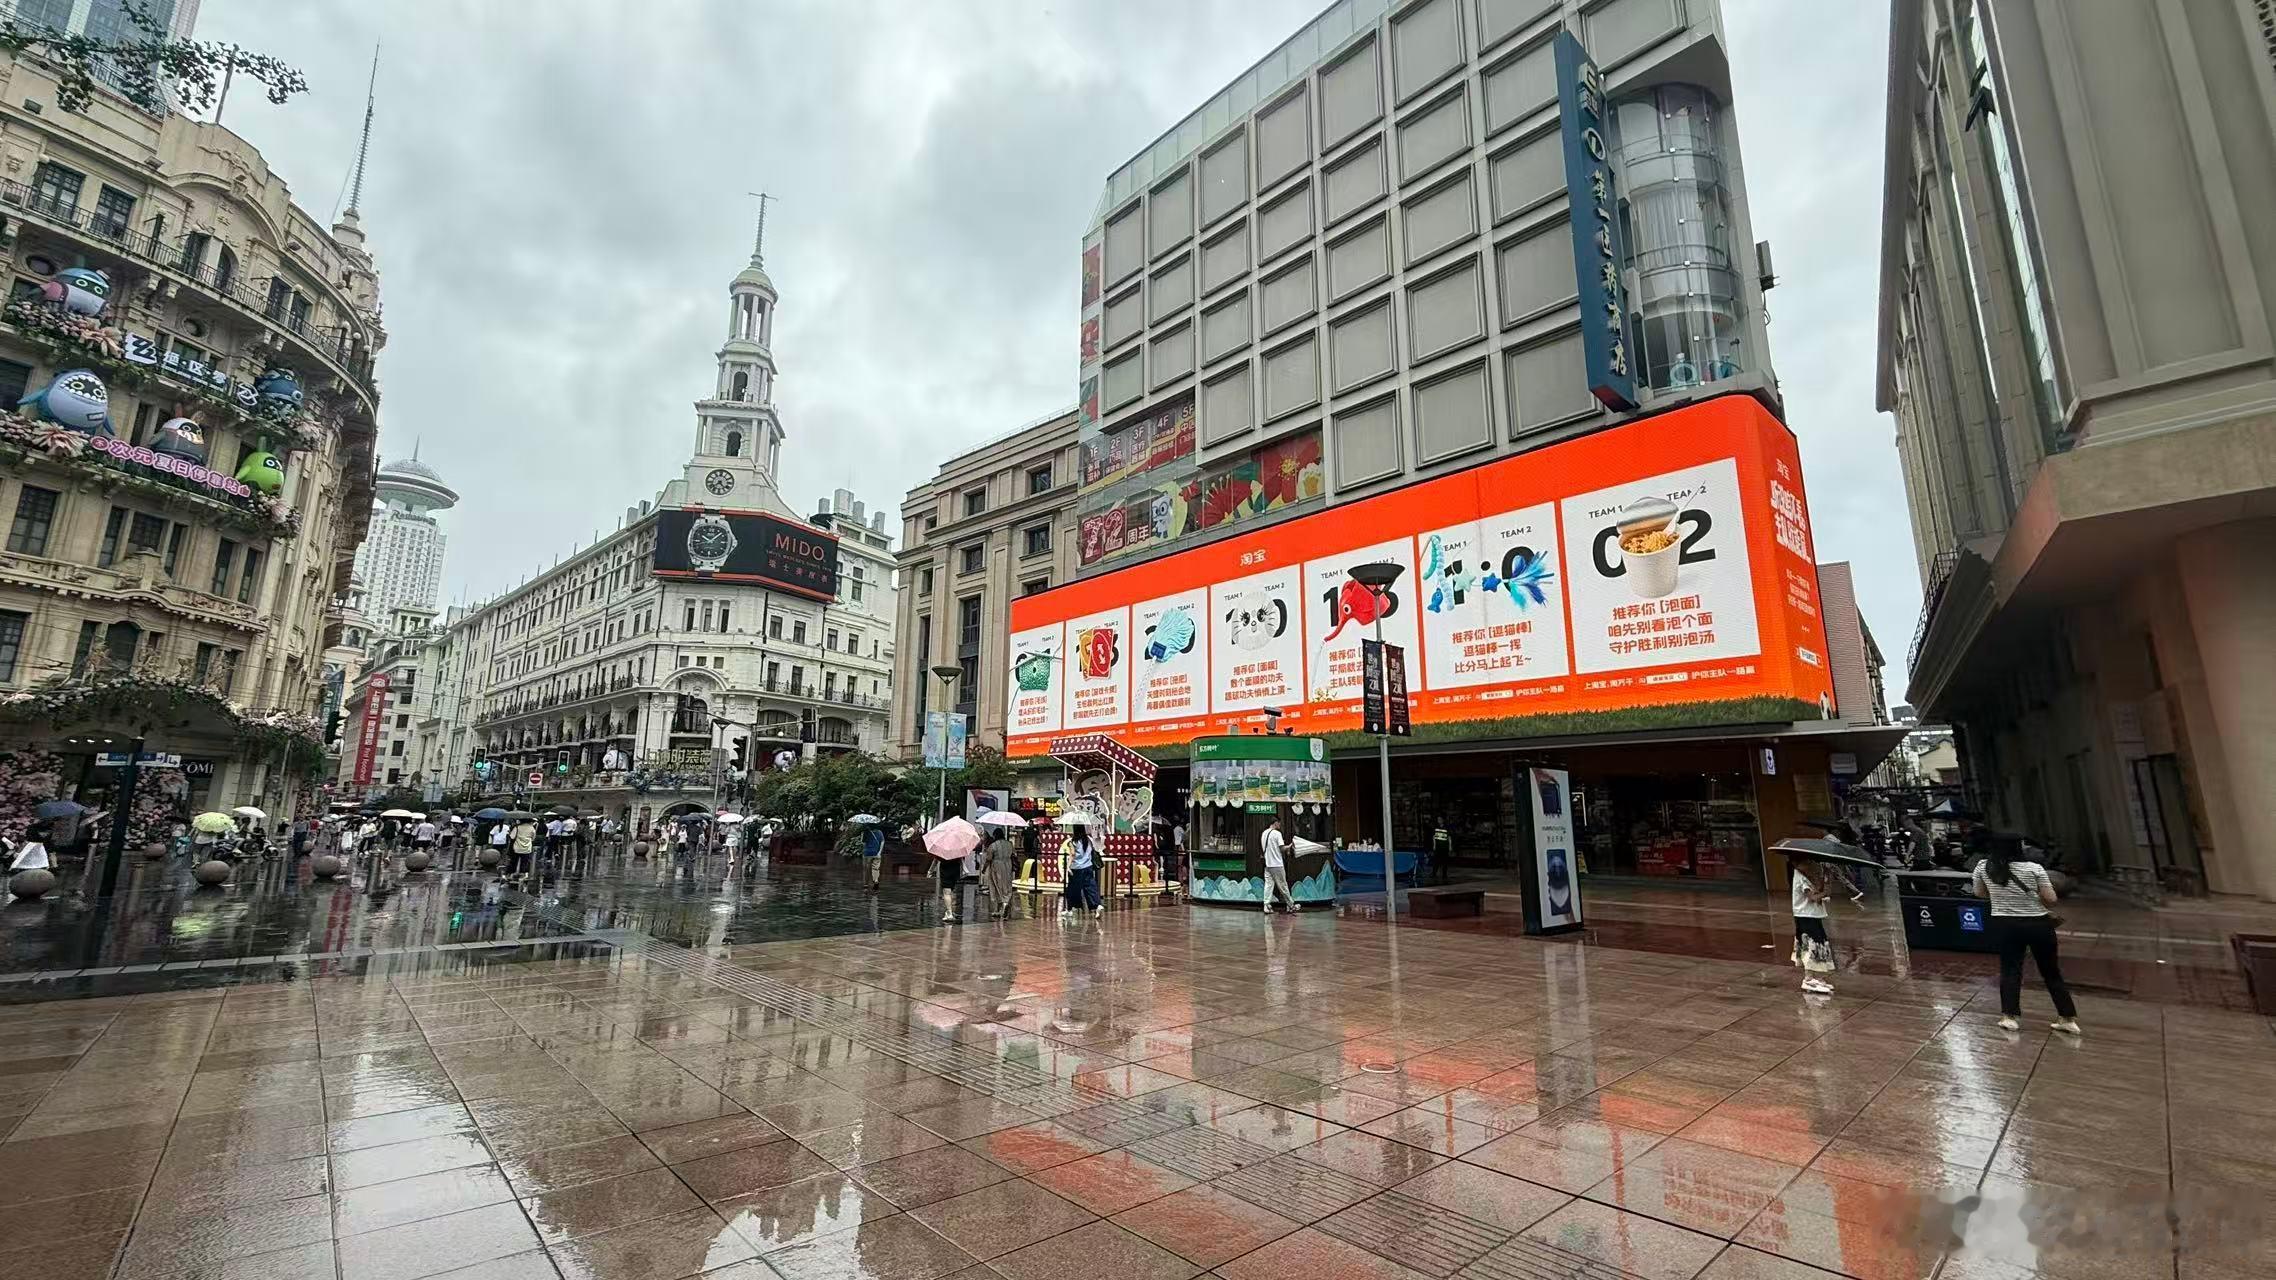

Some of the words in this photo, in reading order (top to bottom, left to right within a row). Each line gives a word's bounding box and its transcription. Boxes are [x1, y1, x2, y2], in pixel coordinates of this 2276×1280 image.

[1182, 404, 1196, 418] 5F
[1157, 415, 1170, 428] 4F
[1133, 426, 1145, 440] 3F
[1110, 436, 1121, 449] 2F
[1090, 446, 1099, 458] 1F
[1700, 485, 1707, 495] 2
[1588, 507, 1616, 519] TEAM
[1617, 504, 1624, 513] 1
[1127, 526, 1149, 545] 周年
[1501, 528, 1525, 539] TEAM
[1526, 526, 1532, 534] 2
[775, 532, 825, 561] MIDO
[1240, 549, 1266, 567] 淘宝
[1321, 570, 1338, 579] TEAM
[1264, 584, 1278, 592] TEAM
[1224, 593, 1238, 601] TEAM
[1177, 604, 1190, 612] TEAM
[1607, 611, 1713, 638] 咱先别看泡个面
[1463, 639, 1522, 657] 逗猫棒一挥
[1608, 631, 1715, 655] 守护胜利别泡汤
